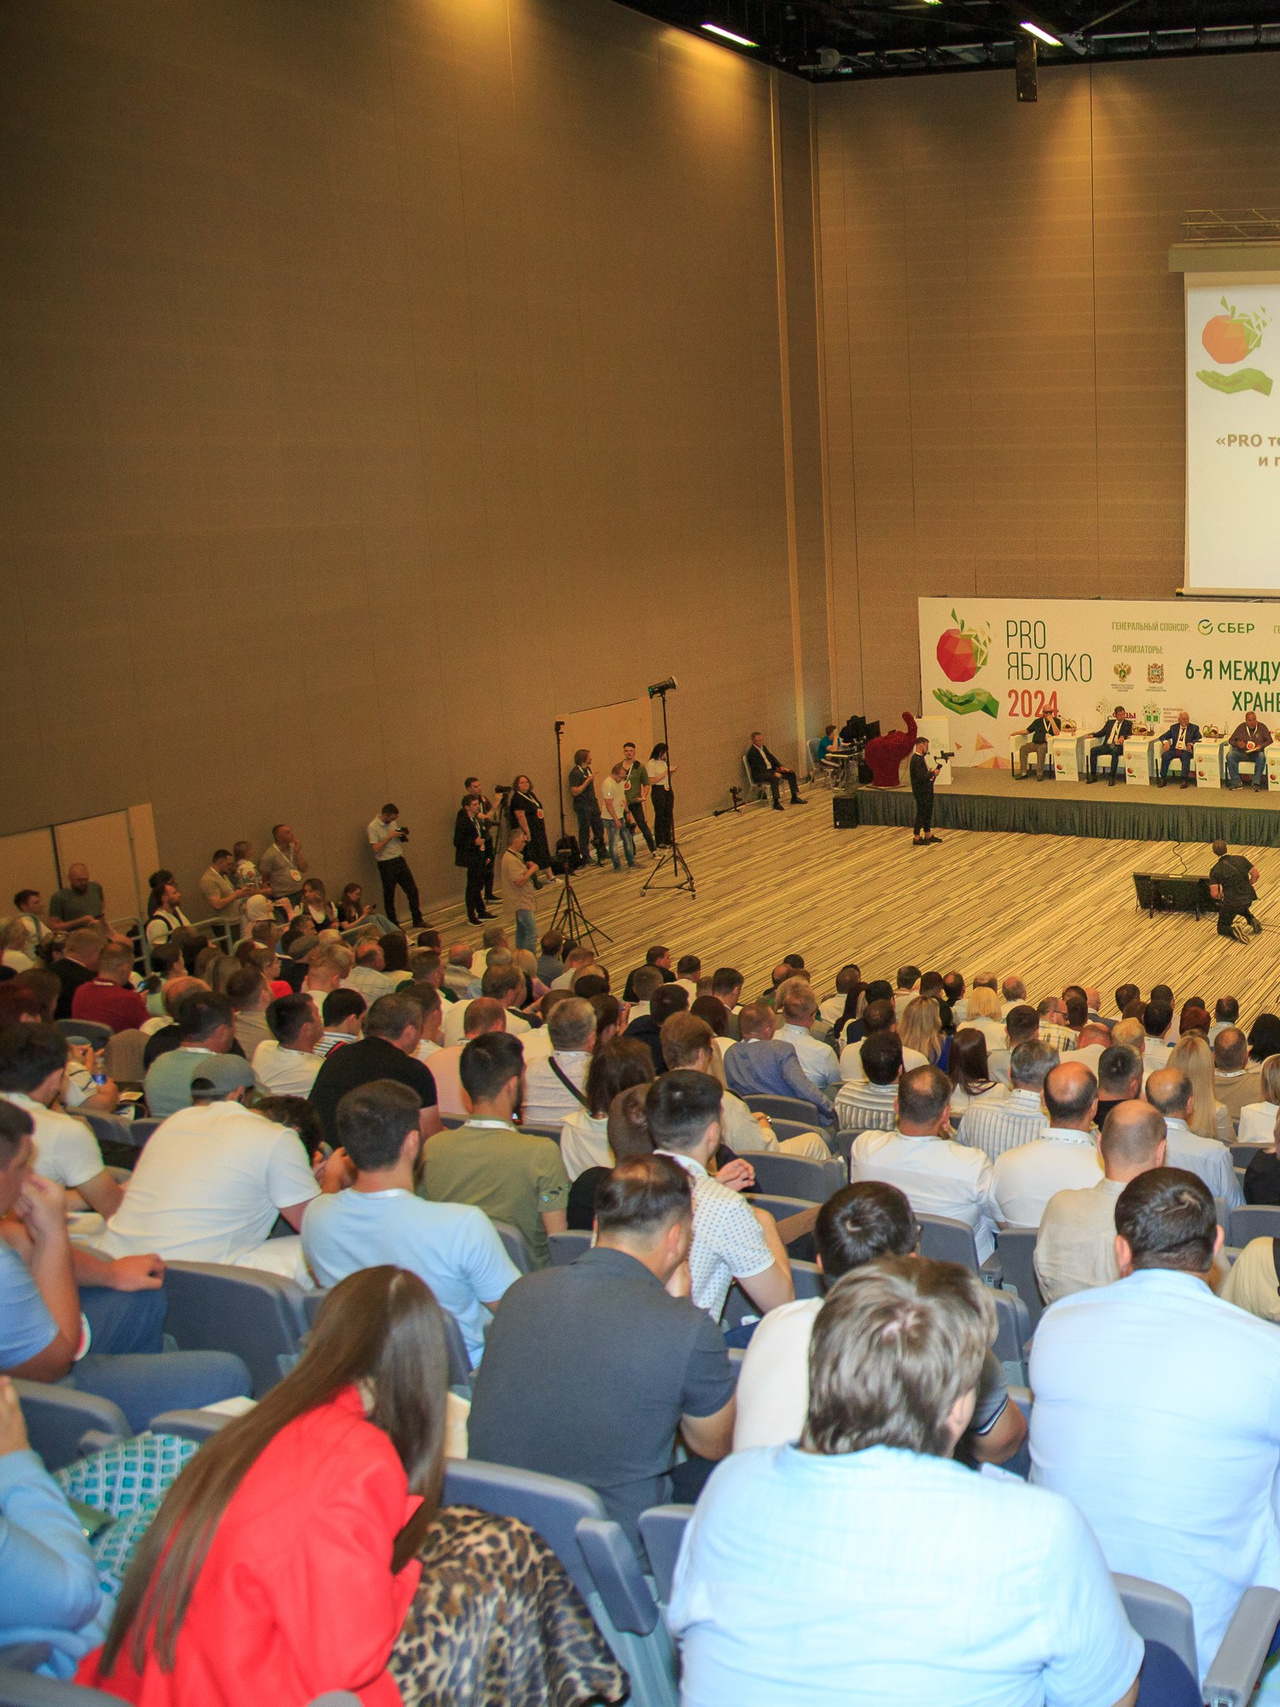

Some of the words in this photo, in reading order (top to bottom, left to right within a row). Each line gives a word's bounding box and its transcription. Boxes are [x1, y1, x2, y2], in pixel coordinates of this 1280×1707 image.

[1216, 434, 1263, 448] «PRO
[1258, 456, 1269, 467] и
[1112, 621, 1159, 632] ГЕНЕРАЛЬНЫЙ
[1160, 622, 1191, 633] СПОНСОР:
[1217, 622, 1255, 634] СБЕР
[1006, 620, 1046, 650] PRO
[1112, 644, 1164, 654] ОРГАНИЗАТОРЫ:
[1007, 652, 1092, 682] ЯБЛОКО
[1185, 659, 1214, 680] 6-Я
